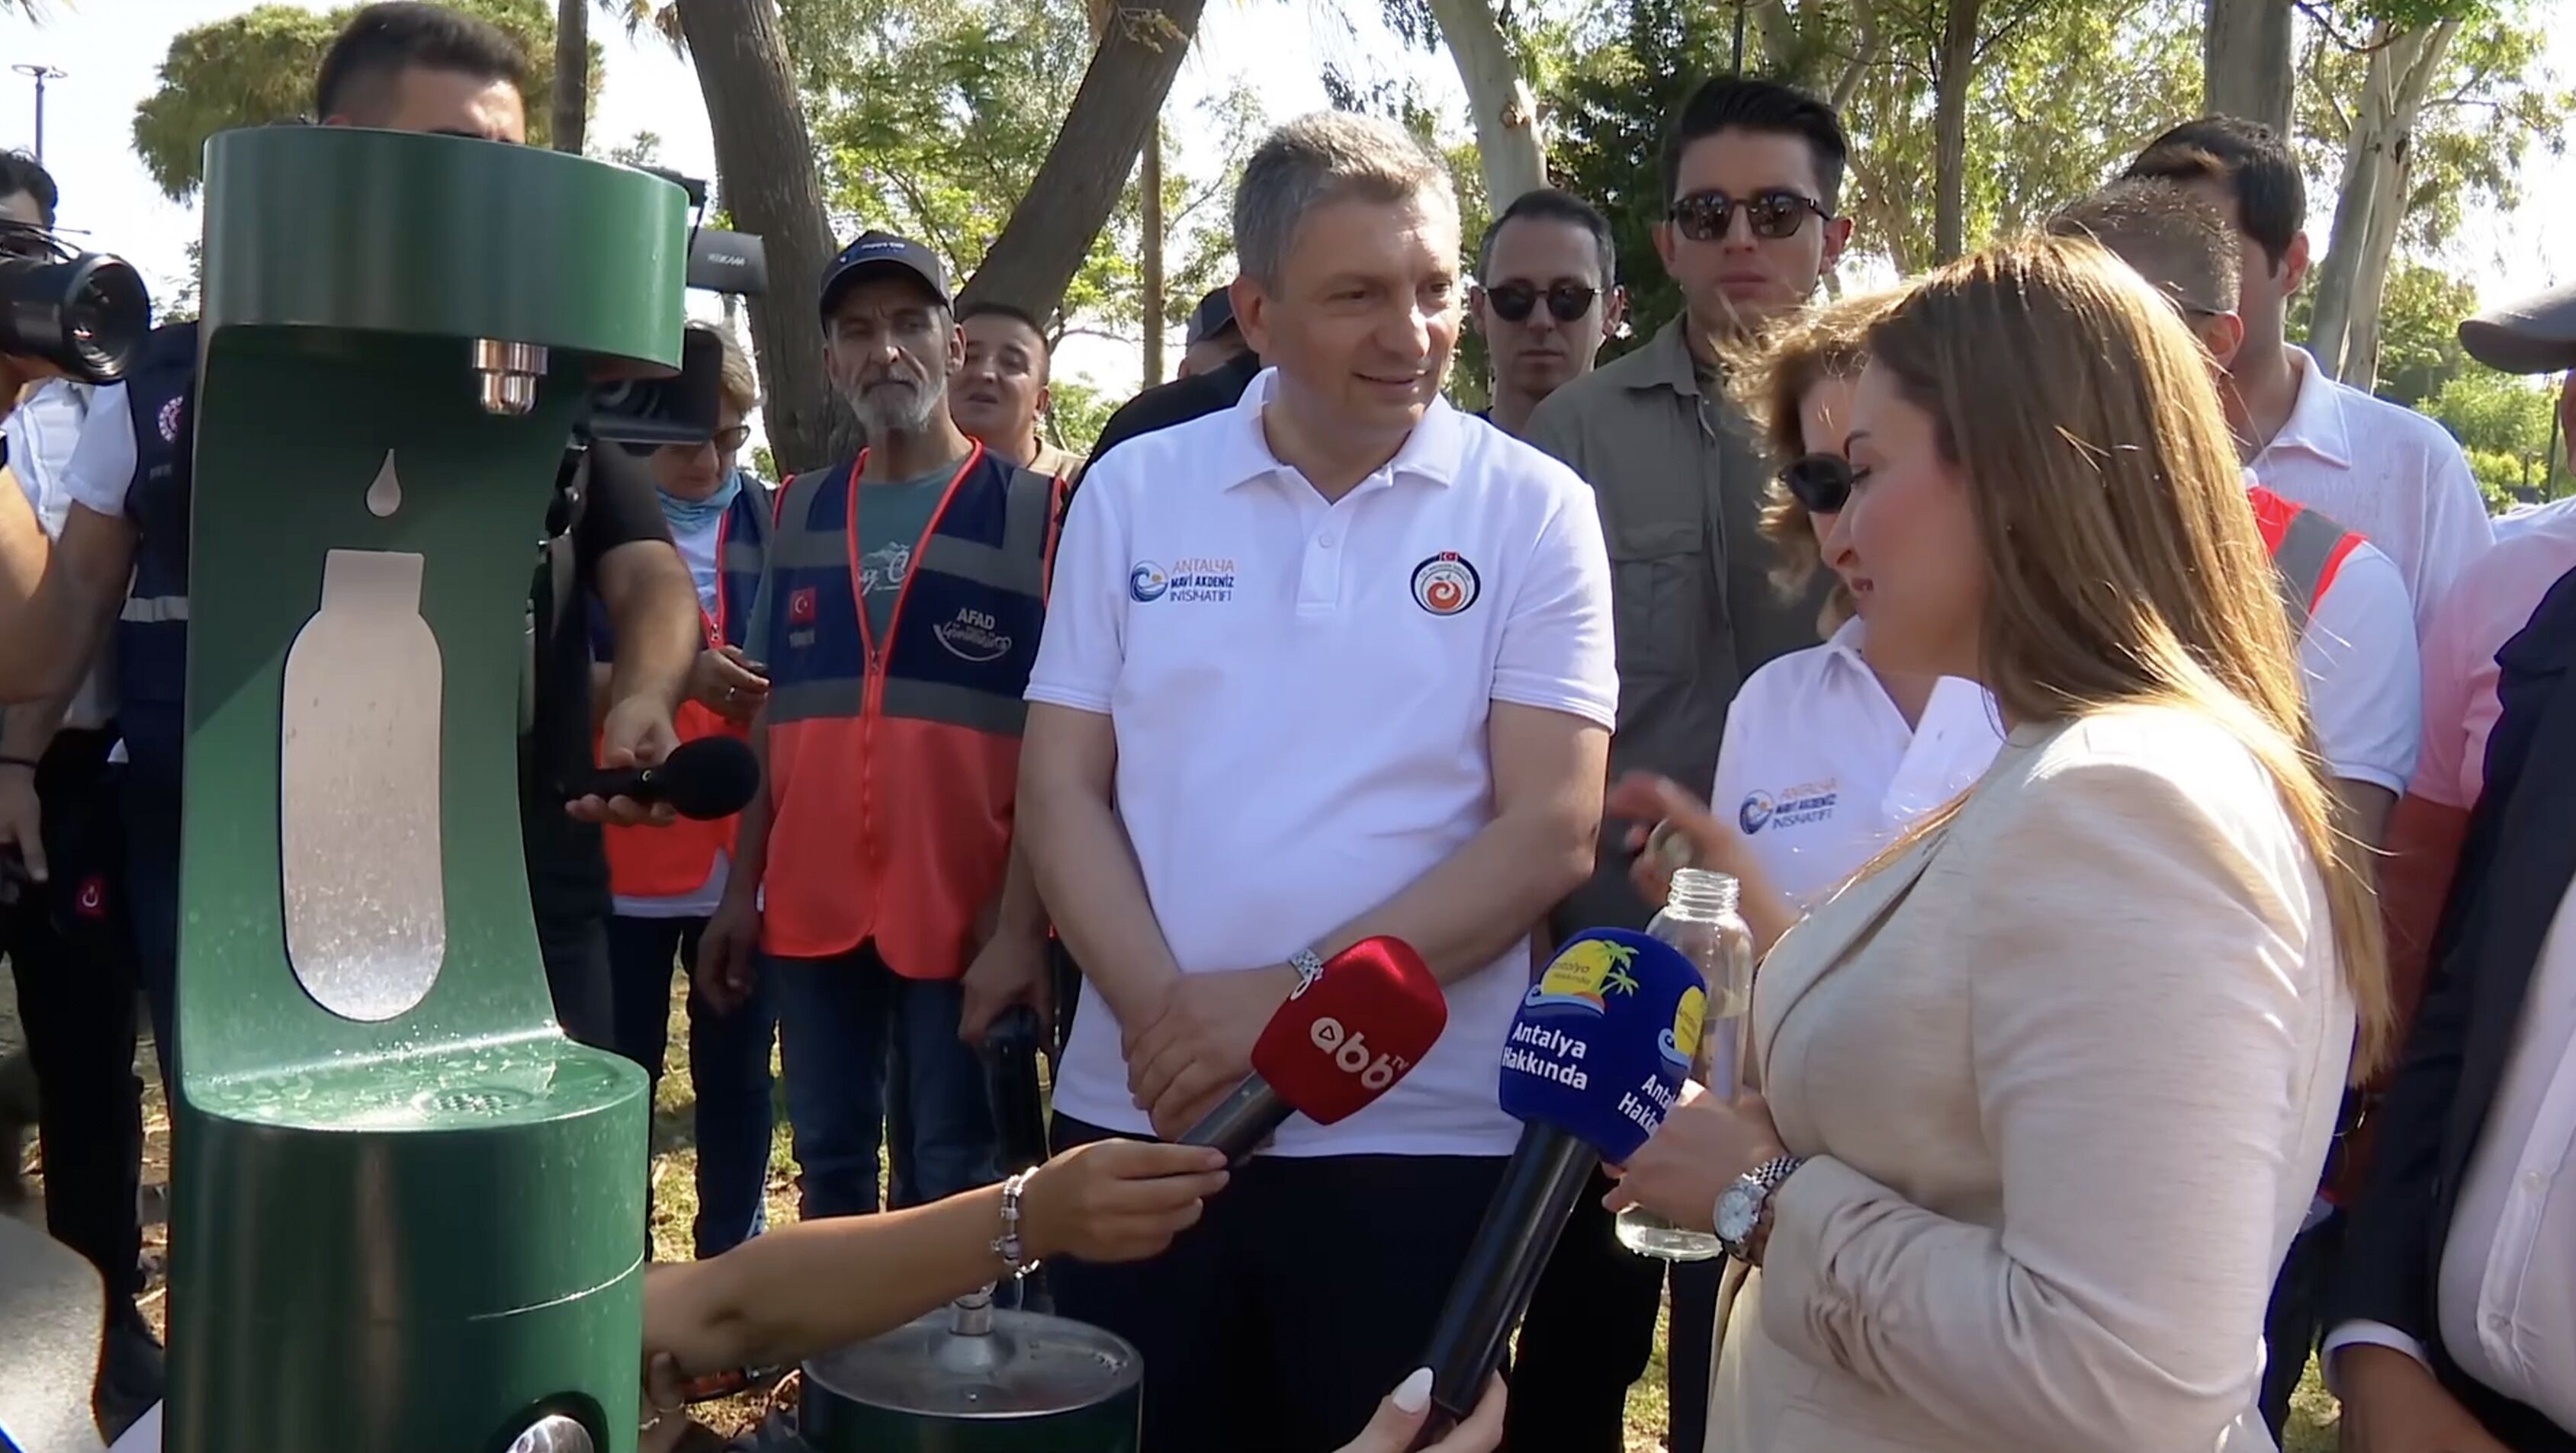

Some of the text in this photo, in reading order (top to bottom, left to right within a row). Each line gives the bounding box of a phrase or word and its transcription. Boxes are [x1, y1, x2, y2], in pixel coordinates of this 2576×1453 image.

[1173, 558, 1235, 573] ANTALYA
[956, 608, 995, 630] AFAD
[1512, 1022, 1587, 1059] Antalya
[1502, 1046, 1588, 1091] Hakkında
[1640, 1073, 1677, 1109] Anta
